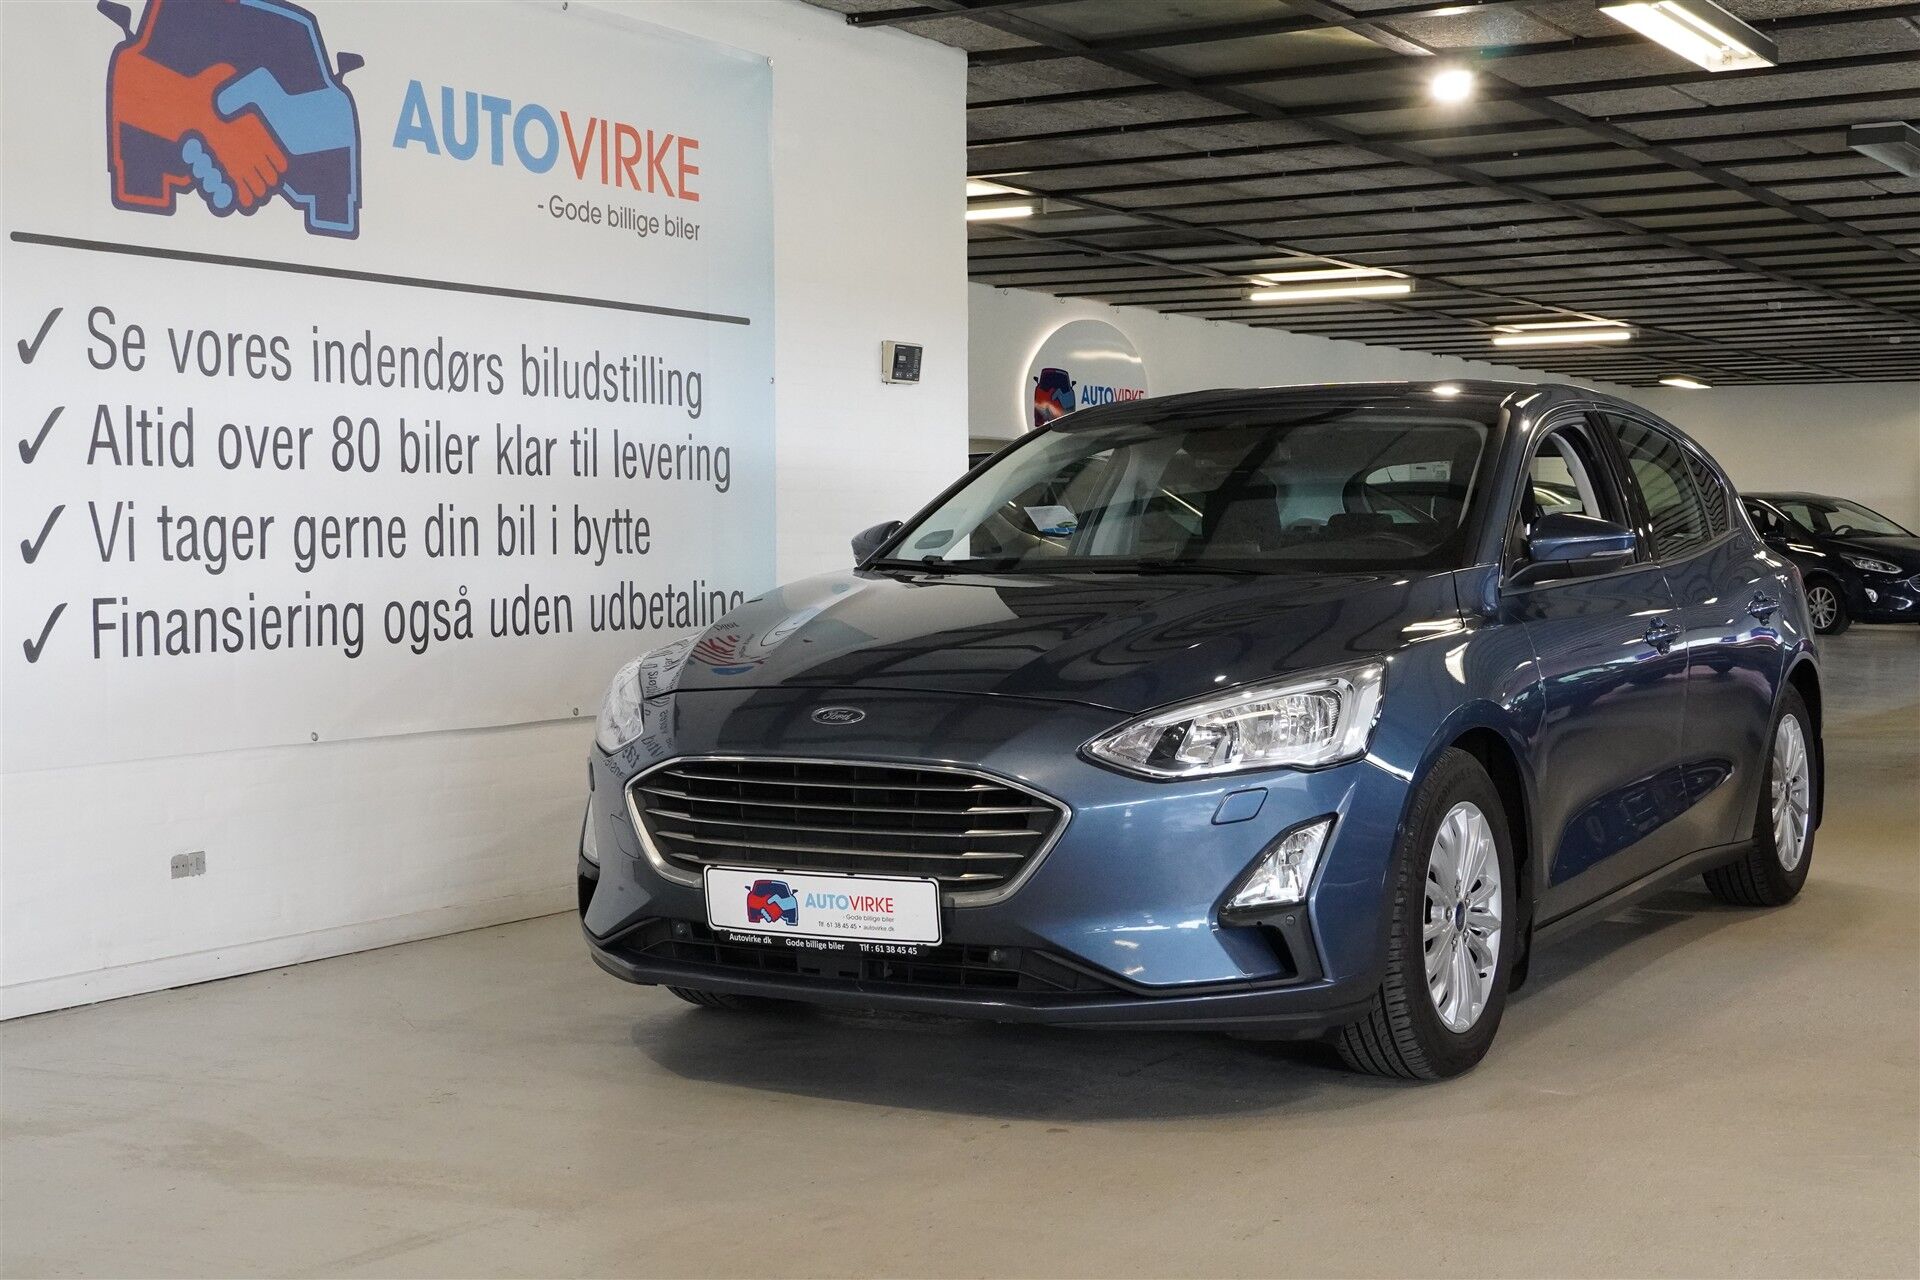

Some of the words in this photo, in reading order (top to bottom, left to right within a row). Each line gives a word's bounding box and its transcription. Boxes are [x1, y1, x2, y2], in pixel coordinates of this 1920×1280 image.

[393, 80, 699, 201] AUTOVIRKE
[549, 195, 601, 224] Gode
[608, 204, 659, 237] billige
[665, 215, 700, 241] biler
[87, 306, 145, 372] Se
[168, 328, 291, 381] vores
[313, 325, 504, 395] indendørs
[522, 344, 702, 419] biludstilling
[87, 404, 194, 468] Altid
[218, 423, 313, 470] over
[332, 415, 380, 472] 80
[400, 418, 479, 475] biler
[497, 423, 557, 477] klar
[570, 427, 597, 477] til
[614, 429, 731, 493] levering
[88, 500, 135, 562] Vi
[157, 505, 274, 575] tager
[294, 515, 407, 573] gerne
[424, 503, 478, 557] din
[498, 504, 534, 556] bil
[552, 505, 557, 555] i
[574, 504, 650, 566] bytte
[92, 591, 363, 659] Finansiering
[384, 585, 473, 655] også
[490, 584, 573, 637] uden
[822, 710, 853, 721] Ford
[805, 893, 894, 913] AUTOVIRKE
[785, 939, 804, 947] Gode
[805, 940, 827, 950] billige
[828, 941, 845, 950] biler
[875, 945, 884, 953] 61
[886, 945, 896, 953] 38
[897, 946, 906, 954] 45
[908, 947, 918, 955] 45
